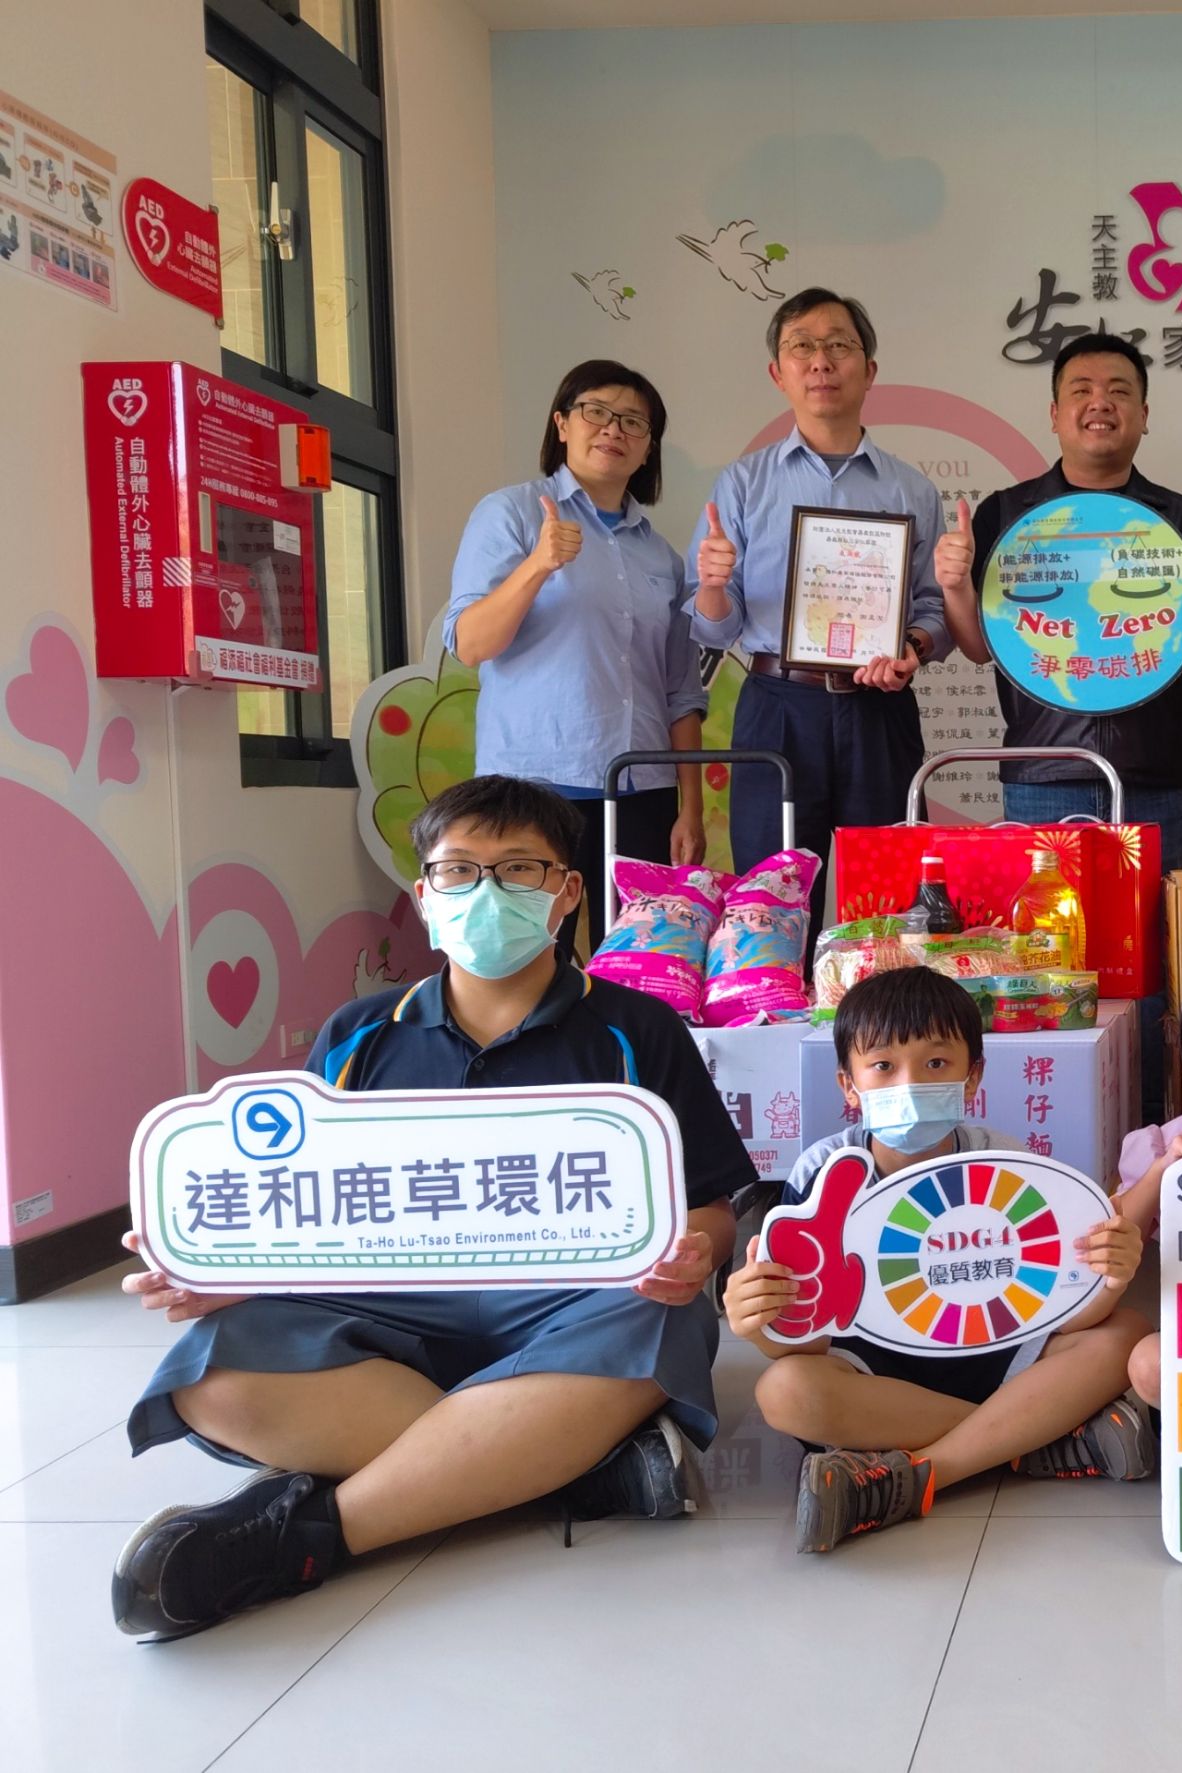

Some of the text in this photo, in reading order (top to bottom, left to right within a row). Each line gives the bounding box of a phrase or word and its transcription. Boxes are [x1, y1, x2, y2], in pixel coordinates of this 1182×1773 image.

[139, 195, 164, 219] AED
[1091, 214, 1118, 301] 天主教
[112, 379, 143, 390] AED
[114, 437, 131, 609] Automated External Defibrillator
[128, 437, 154, 609] 自動體外心臟去顫器
[1015, 607, 1176, 639] Net Zero
[1031, 648, 1163, 681] 淨零碳排
[185, 1151, 613, 1233] 達和鹿草環保
[358, 1227, 596, 1249] Ta-Ho Lu-Tsao Environment Co., Ltd.
[927, 1226, 1013, 1254] SDG4
[927, 1256, 1015, 1286] 優質教育
